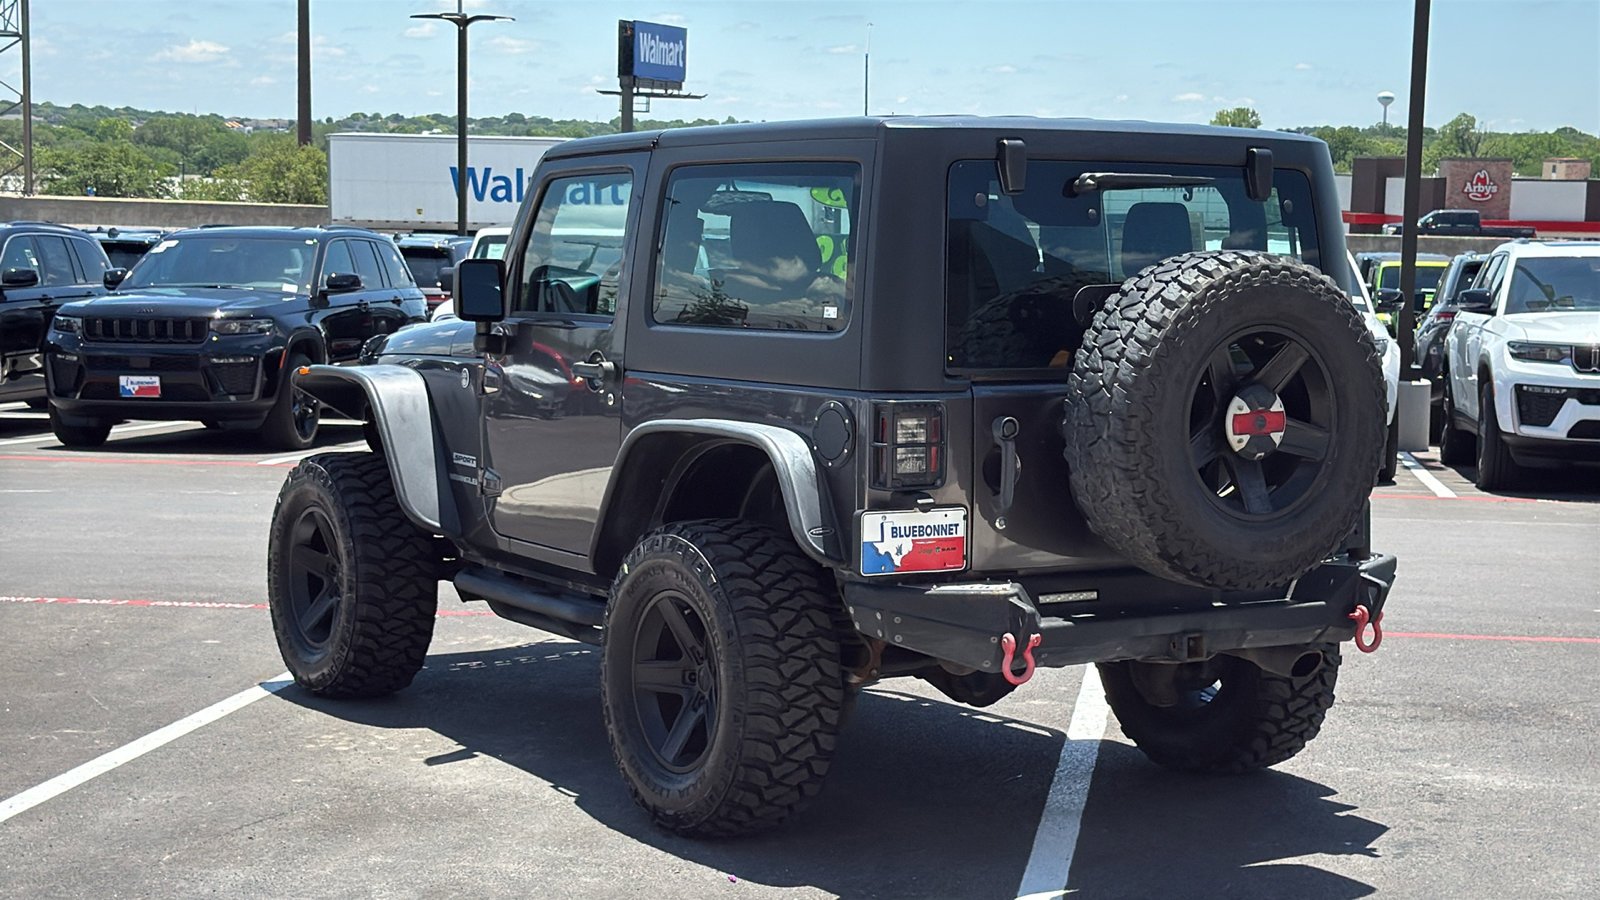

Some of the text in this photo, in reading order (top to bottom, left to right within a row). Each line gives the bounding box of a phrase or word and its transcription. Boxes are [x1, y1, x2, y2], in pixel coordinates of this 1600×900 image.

[640, 32, 684, 68] Walmart
[449, 166, 624, 206] Walart
[1463, 181, 1498, 195] Arby's
[455, 454, 476, 465] SPORT
[890, 523, 960, 538] BLUEBONNET
